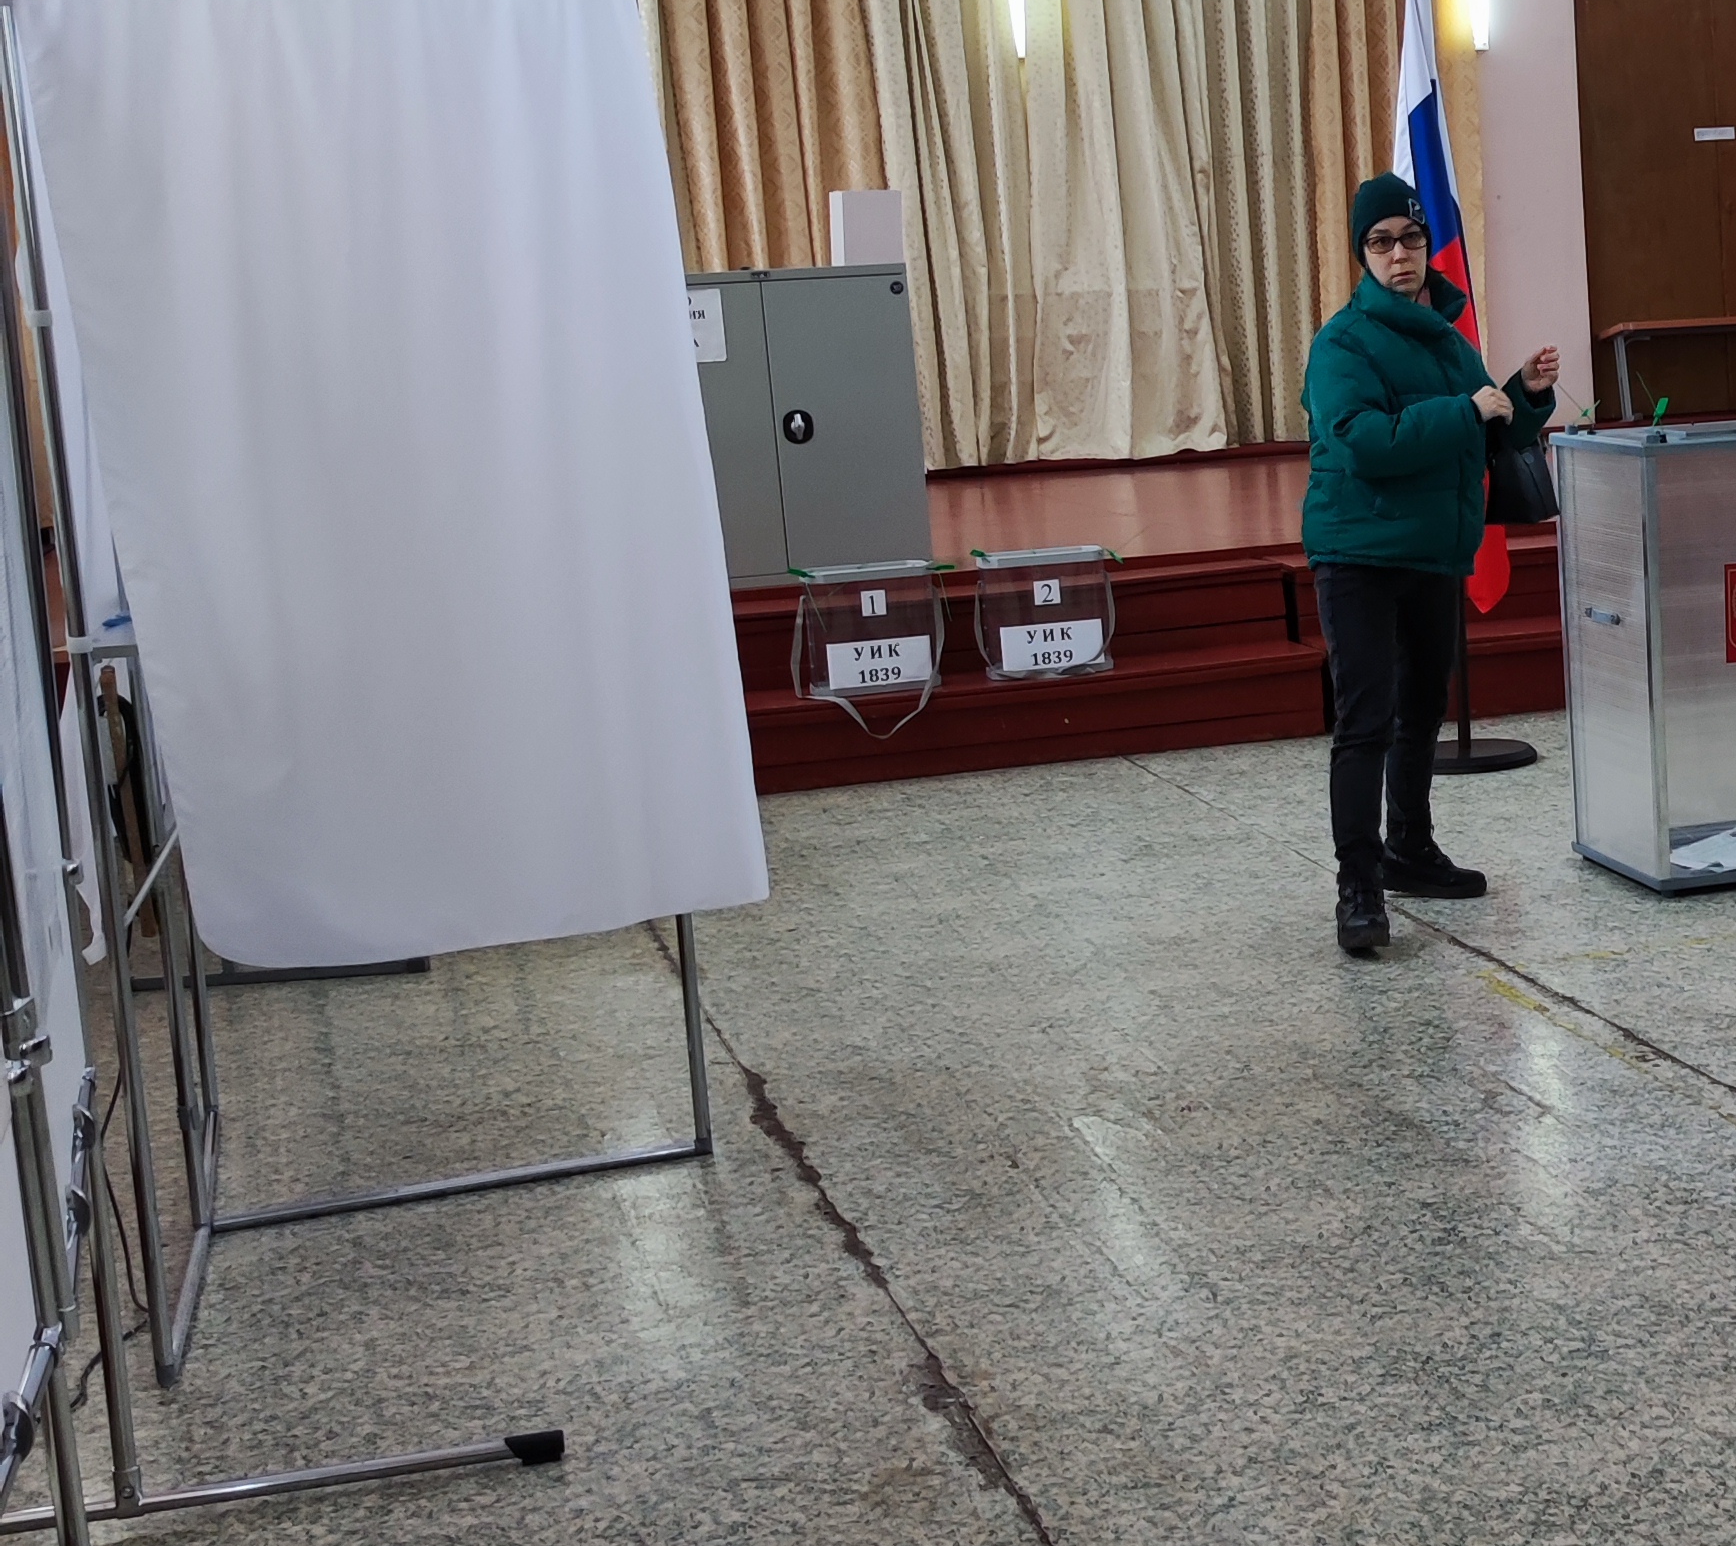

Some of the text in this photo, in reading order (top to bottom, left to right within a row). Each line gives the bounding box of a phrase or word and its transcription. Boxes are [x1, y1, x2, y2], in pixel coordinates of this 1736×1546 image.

[1040, 584, 1054, 603] 2
[868, 595, 877, 615] 1
[1031, 649, 1074, 666] 1839
[858, 666, 902, 684] 1839
